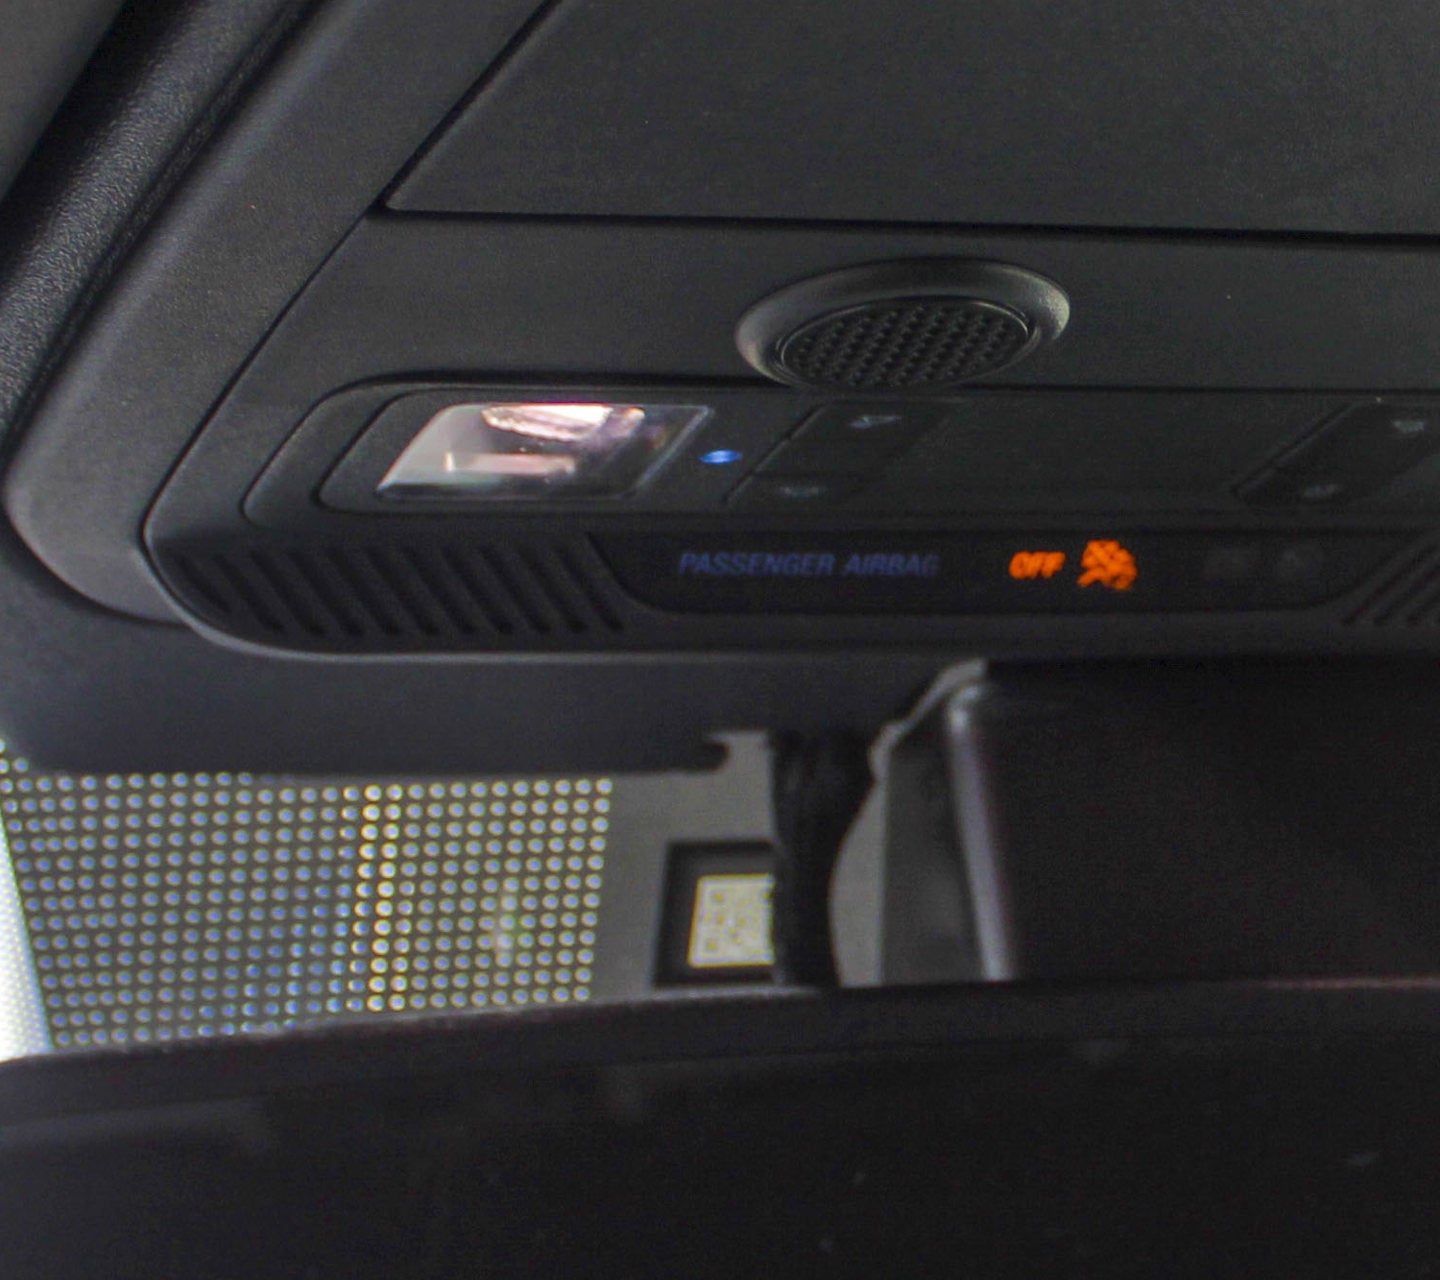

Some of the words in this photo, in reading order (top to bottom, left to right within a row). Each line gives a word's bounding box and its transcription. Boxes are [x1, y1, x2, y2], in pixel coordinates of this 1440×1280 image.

[678, 551, 835, 576] PASSENGER
[843, 552, 941, 577] AIRBAG
[1007, 550, 1066, 580] OFF
